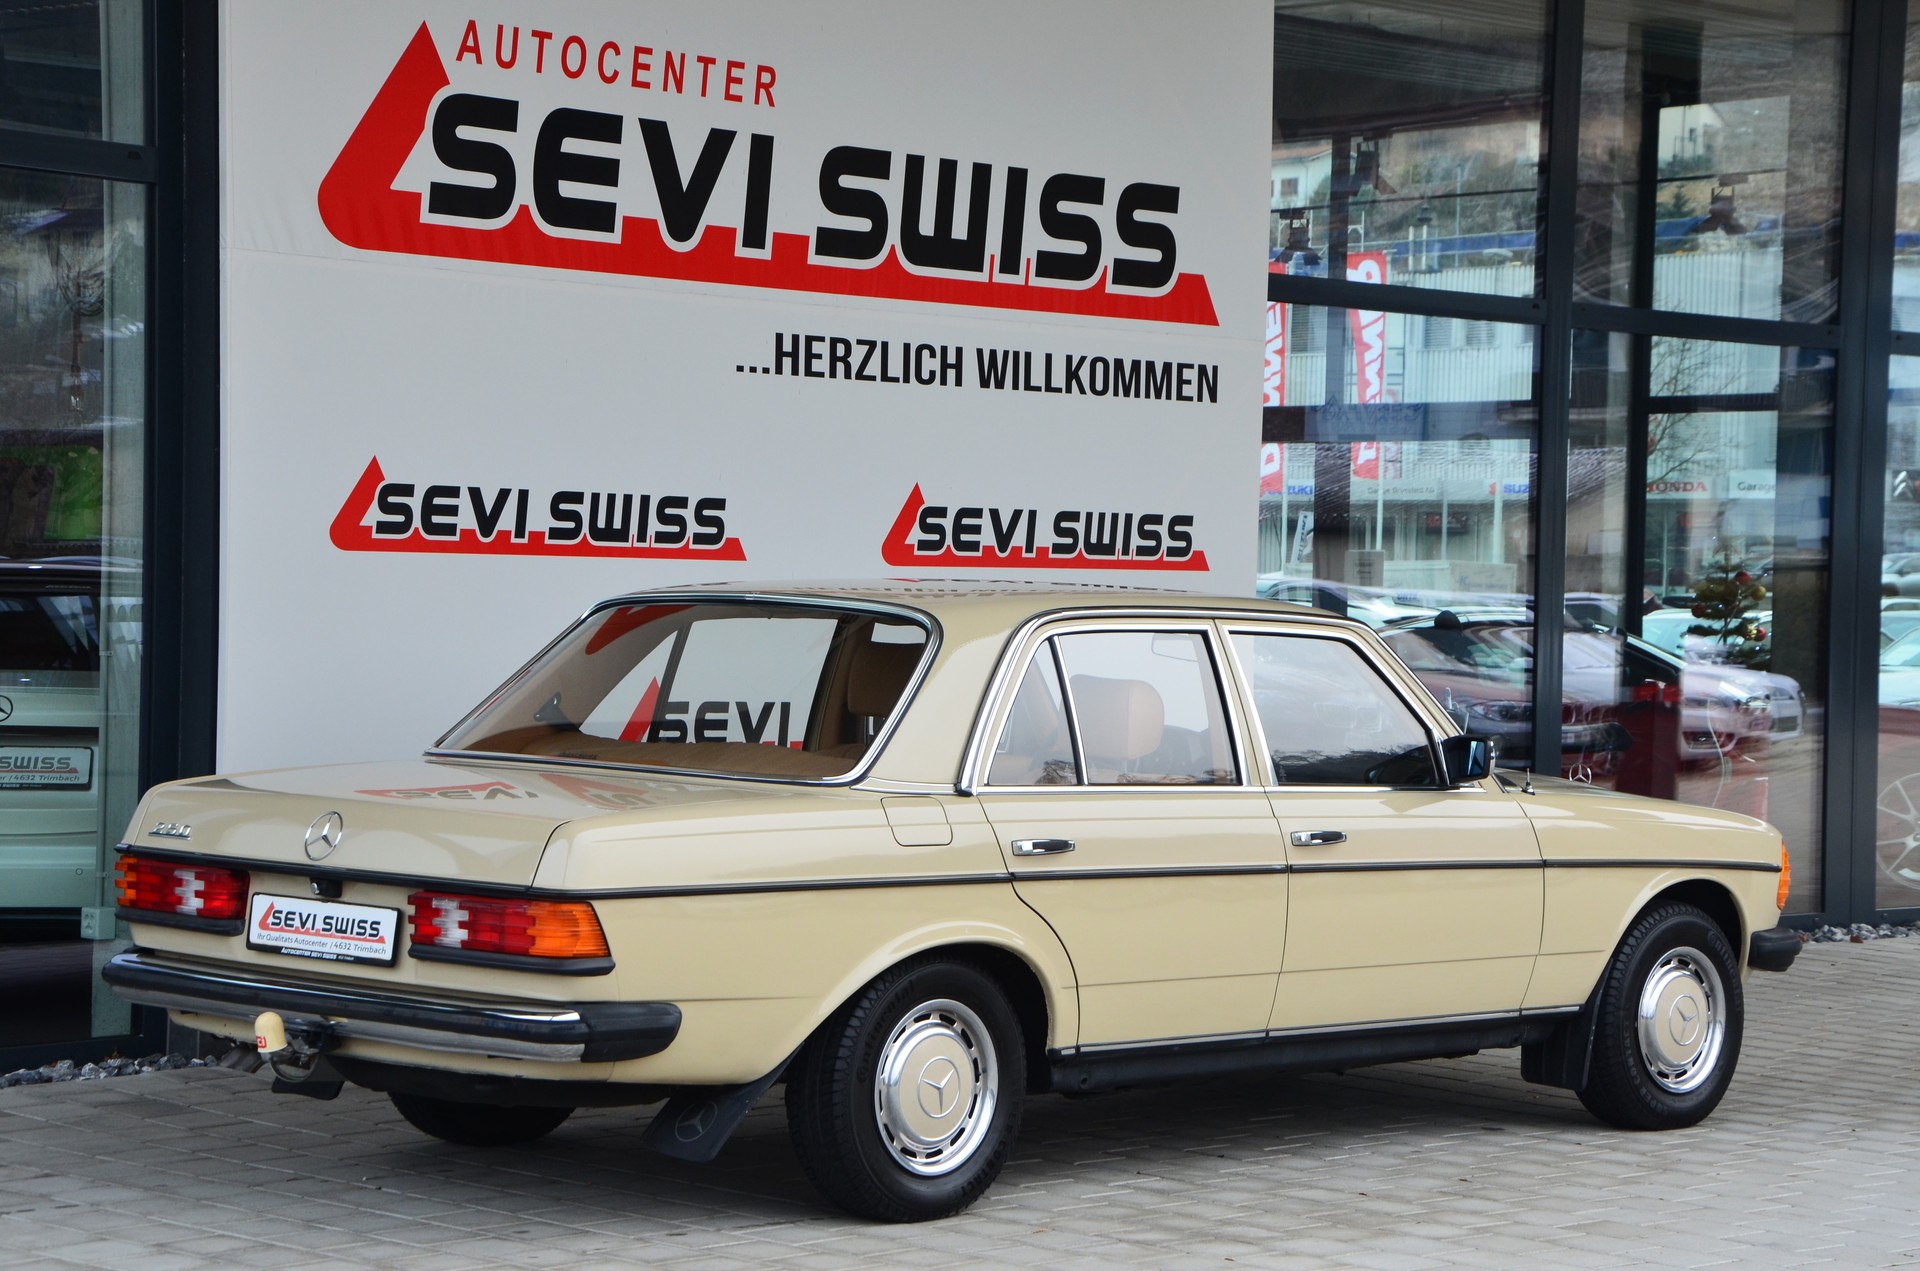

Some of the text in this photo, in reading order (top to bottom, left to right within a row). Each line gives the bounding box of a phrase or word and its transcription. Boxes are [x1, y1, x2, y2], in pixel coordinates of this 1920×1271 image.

[456, 20, 777, 107] AUTOCENTER
[428, 93, 1180, 289] SEVI SWISS
[976, 347, 1219, 404] WILLKOMMEN
[375, 483, 727, 546] SEVI SWISS
[916, 506, 1194, 558] SEVI SWISS
[656, 701, 791, 748] SEVI
[39, 774, 80, 782] Trimbach
[152, 822, 191, 837] 250
[257, 932, 266, 940] Ihr
[294, 937, 329, 948] Autocenter
[334, 941, 351, 951] 4632
[353, 944, 387, 955] Trimbach
[271, 910, 381, 938] SEVI SWISS
